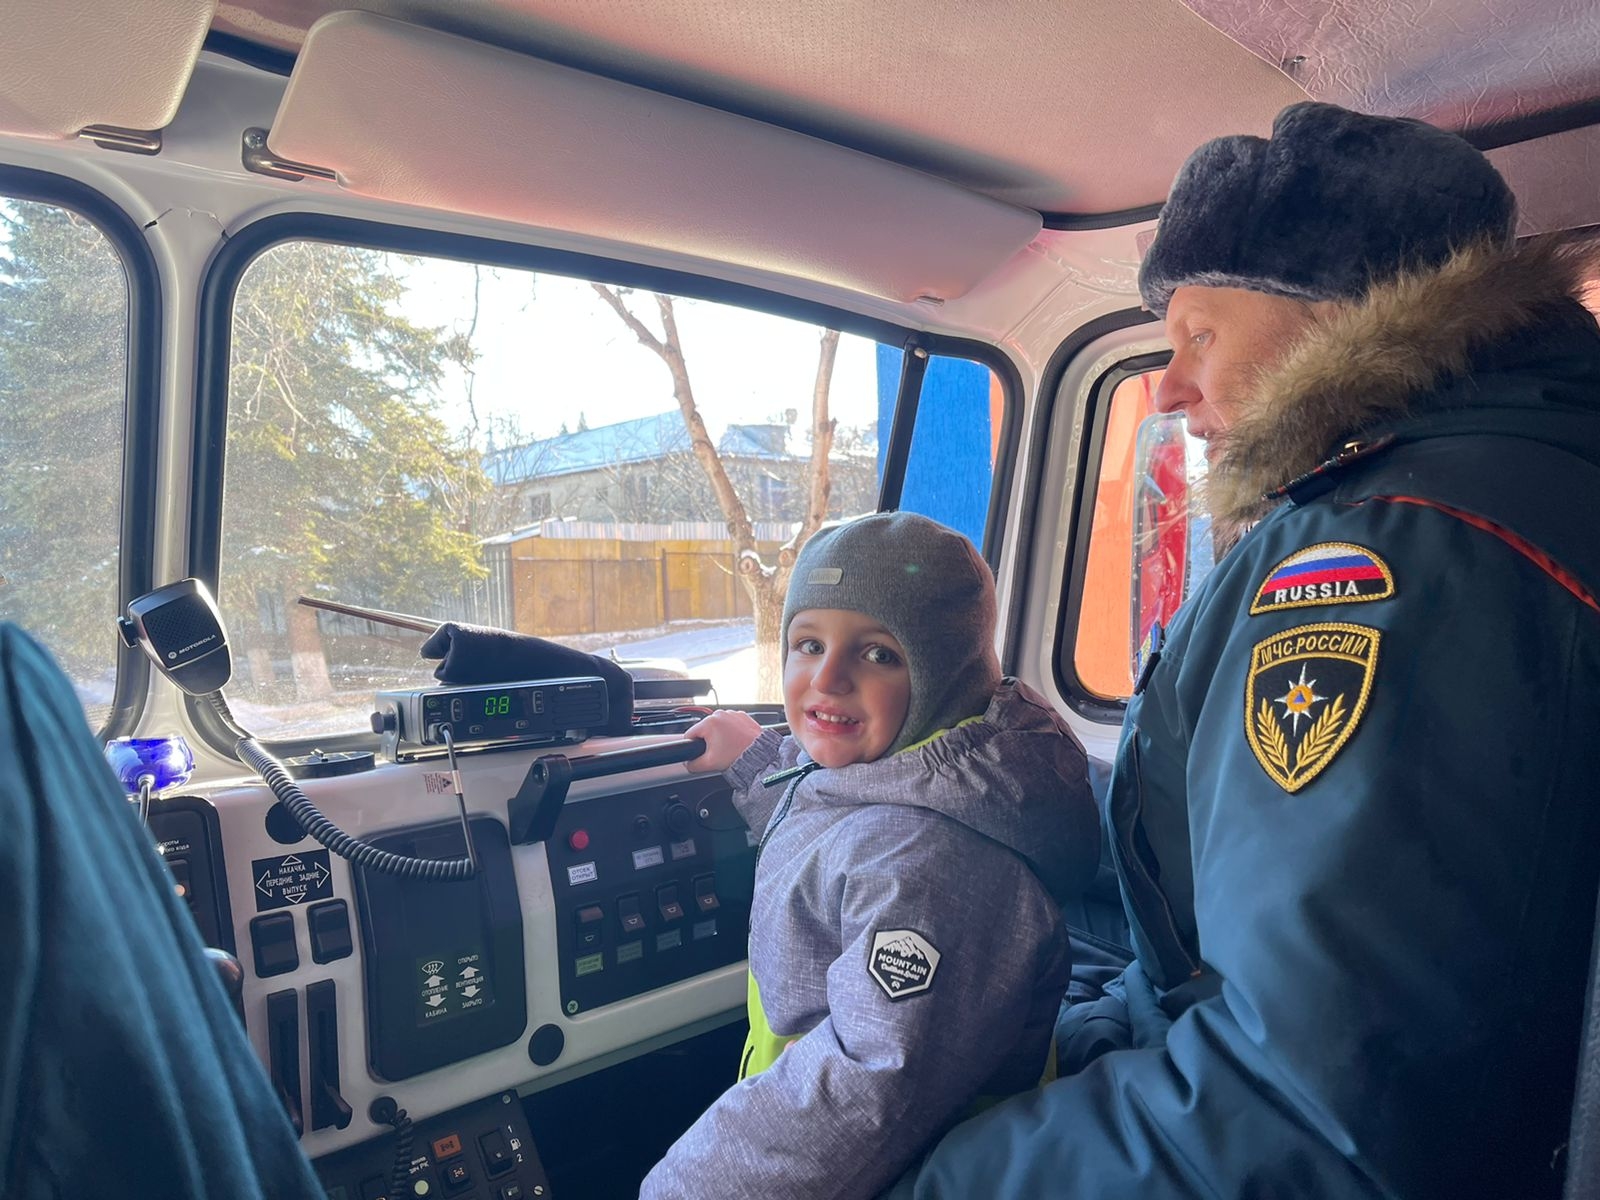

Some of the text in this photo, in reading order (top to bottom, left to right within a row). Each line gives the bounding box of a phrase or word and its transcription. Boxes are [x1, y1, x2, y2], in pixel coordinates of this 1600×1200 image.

[1274, 580, 1359, 603] RUSSIA
[179, 635, 216, 654] MOTOROLA
[1260, 634, 1369, 665] МЧС РОССИИ
[485, 696, 509, 715] 08
[279, 864, 306, 875] НАКАЧКА
[266, 871, 320, 888] ПЕРЕДНИЕ ЗАДНИЕ
[282, 884, 308, 896] ВЫПУСК
[878, 953, 927, 975] MOUNTAIN
[516, 1153, 524, 1163] 2
